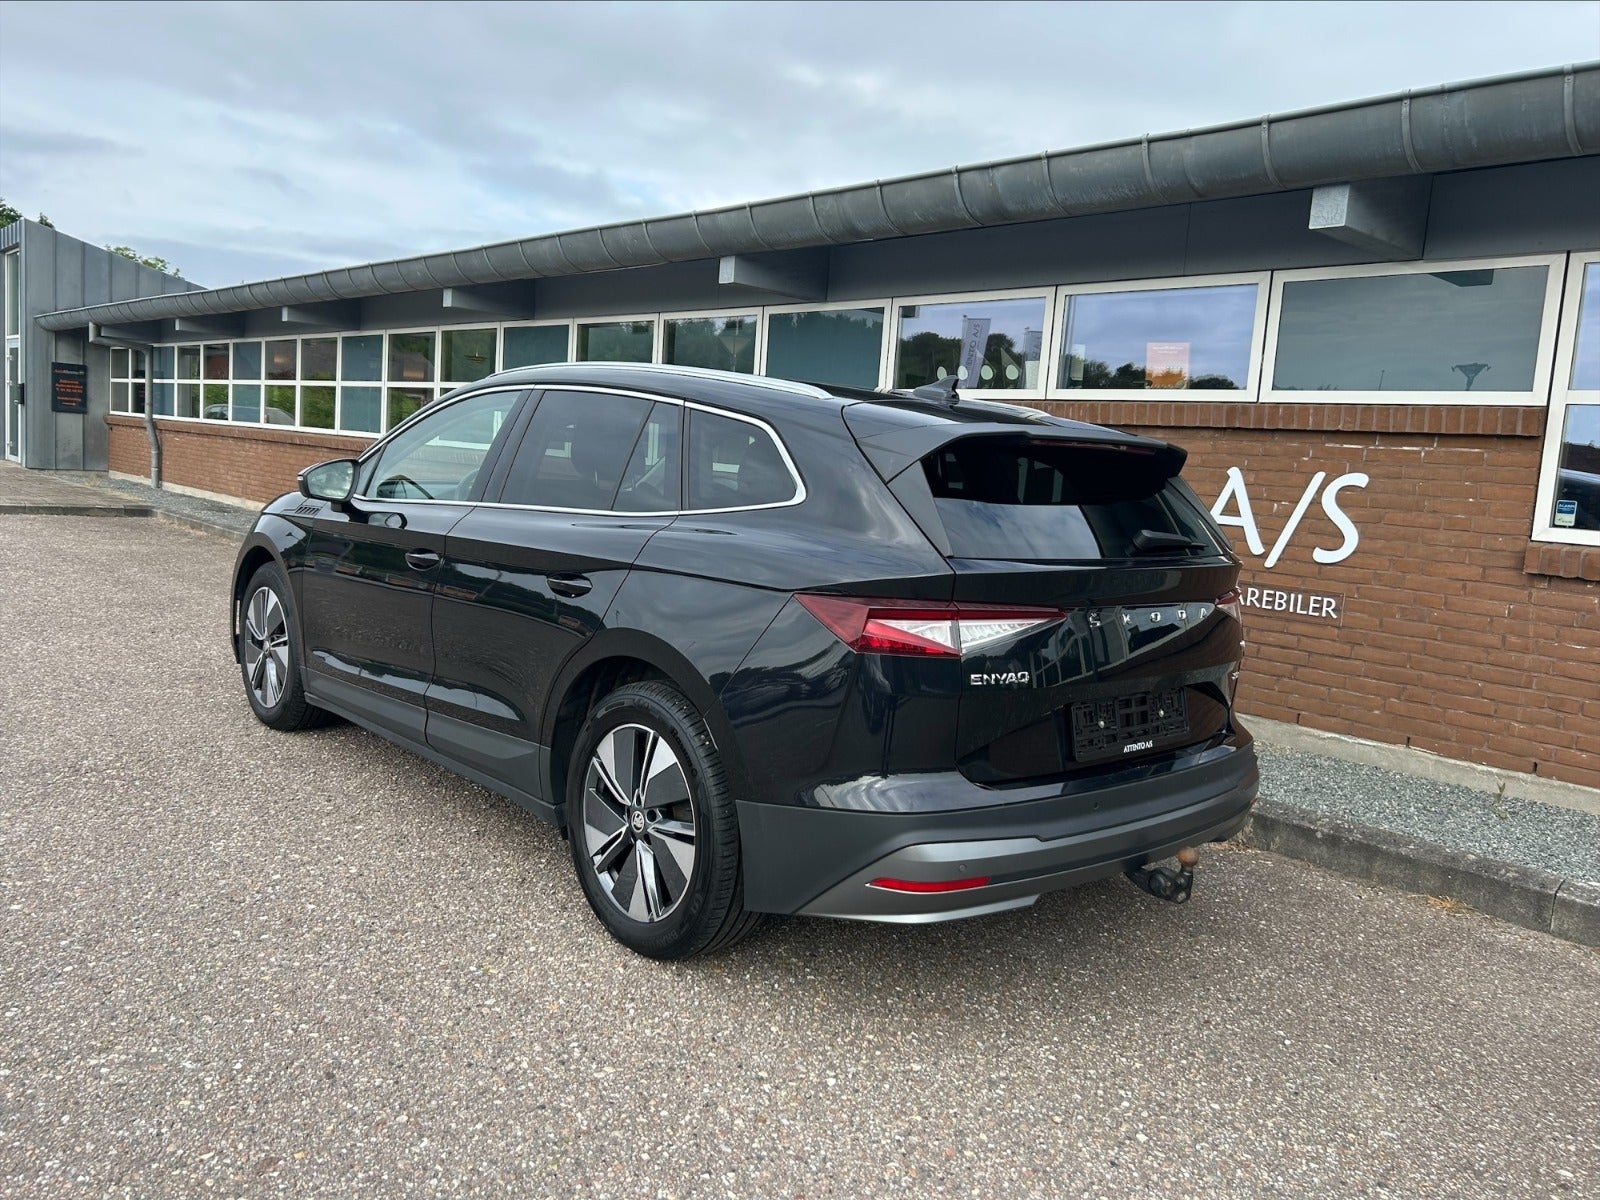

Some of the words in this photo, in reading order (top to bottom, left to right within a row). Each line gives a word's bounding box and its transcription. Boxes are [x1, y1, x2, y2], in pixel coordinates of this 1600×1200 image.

[1209, 466, 1370, 568] A/S
[970, 671, 1030, 686] ENYAQ
[1123, 741, 1146, 753] ATTENTO
